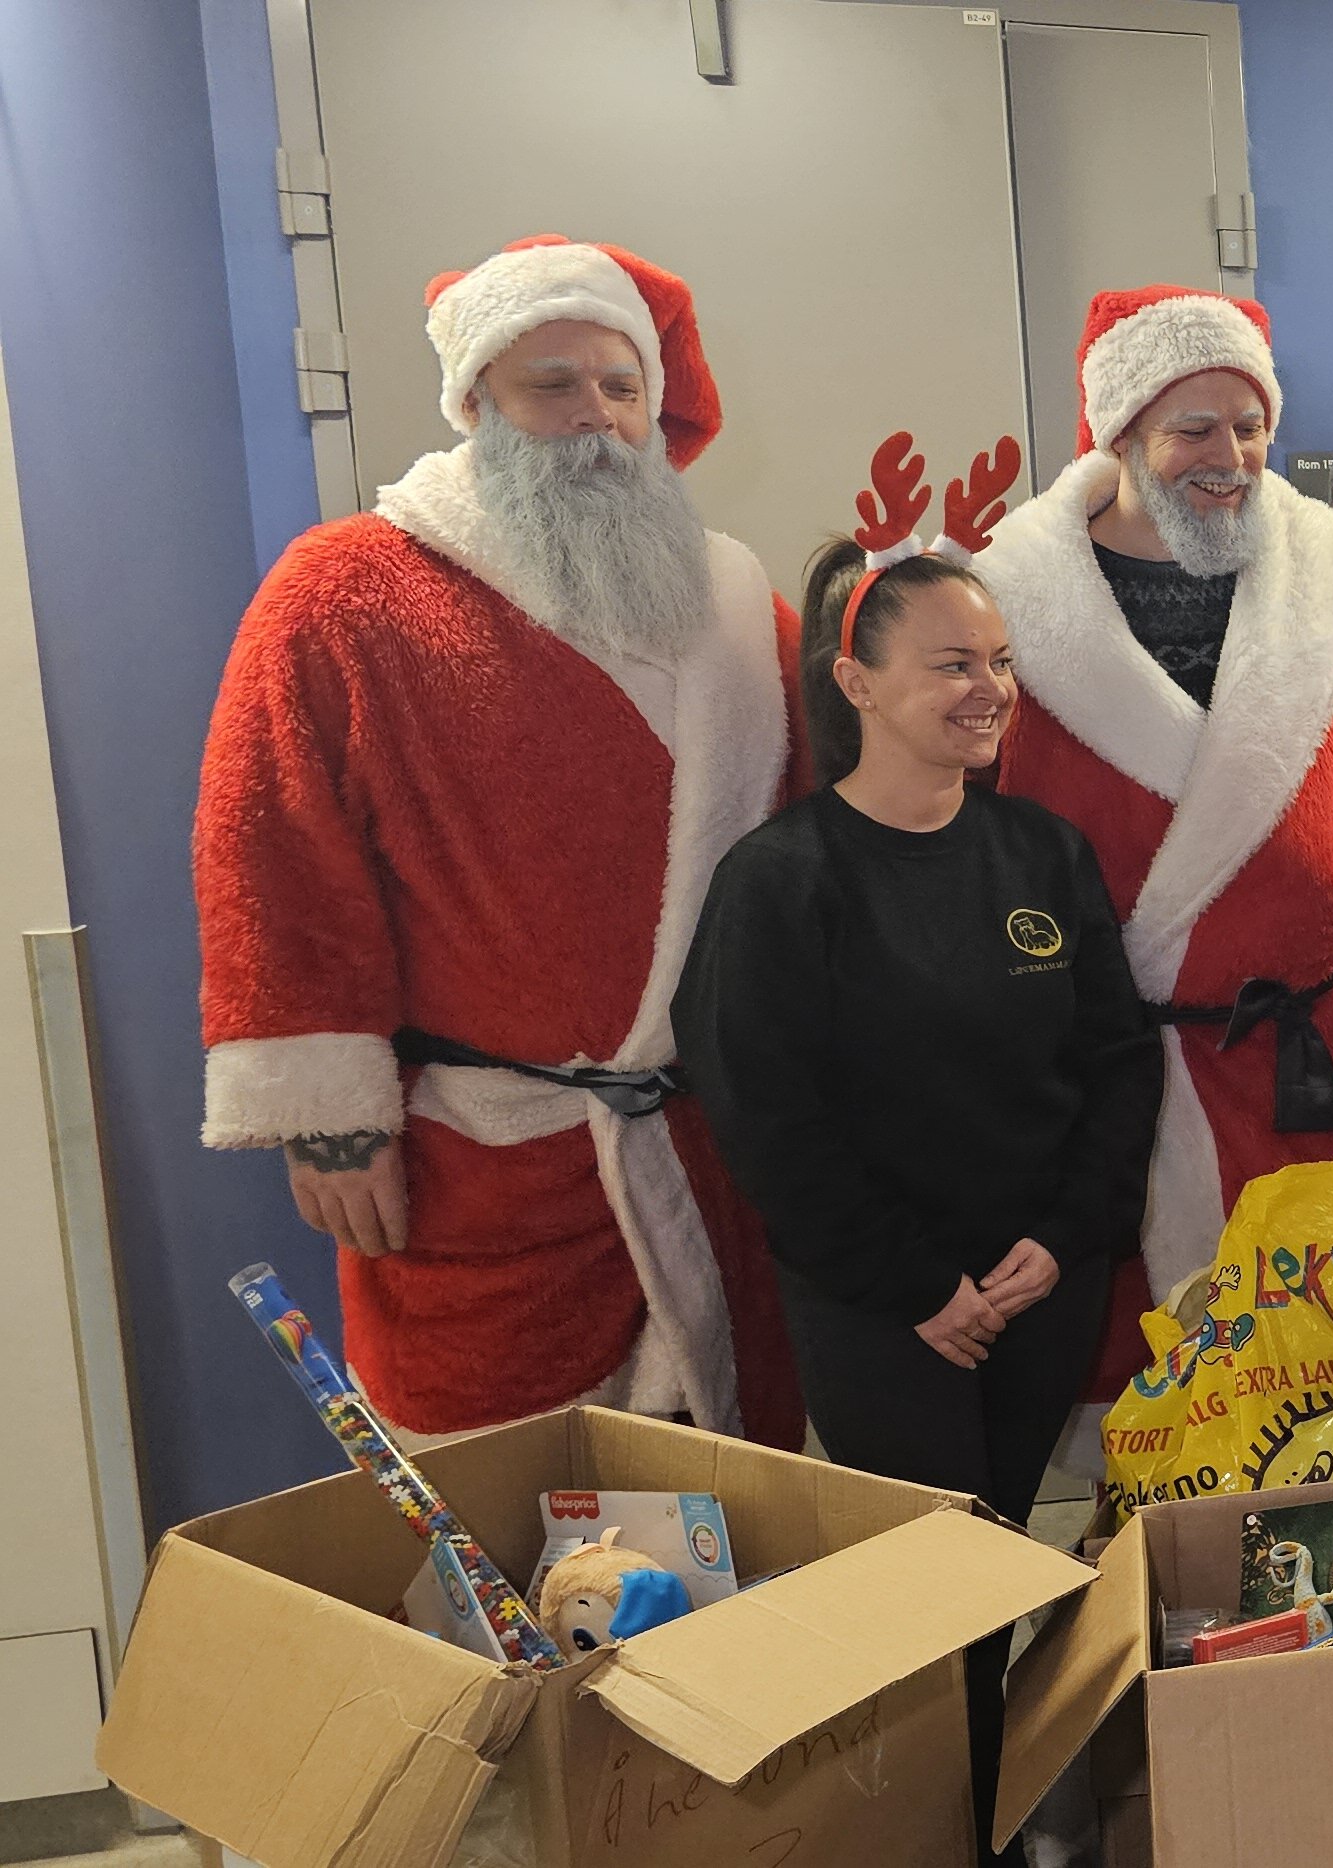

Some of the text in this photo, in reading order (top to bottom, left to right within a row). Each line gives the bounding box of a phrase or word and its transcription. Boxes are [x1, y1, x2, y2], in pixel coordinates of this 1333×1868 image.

[967, 13, 991, 22] B2-49
[1297, 459, 1320, 470] Rom
[1106, 1427, 1175, 1455] STORT
[1234, 1365, 1294, 1399] EXTRA
